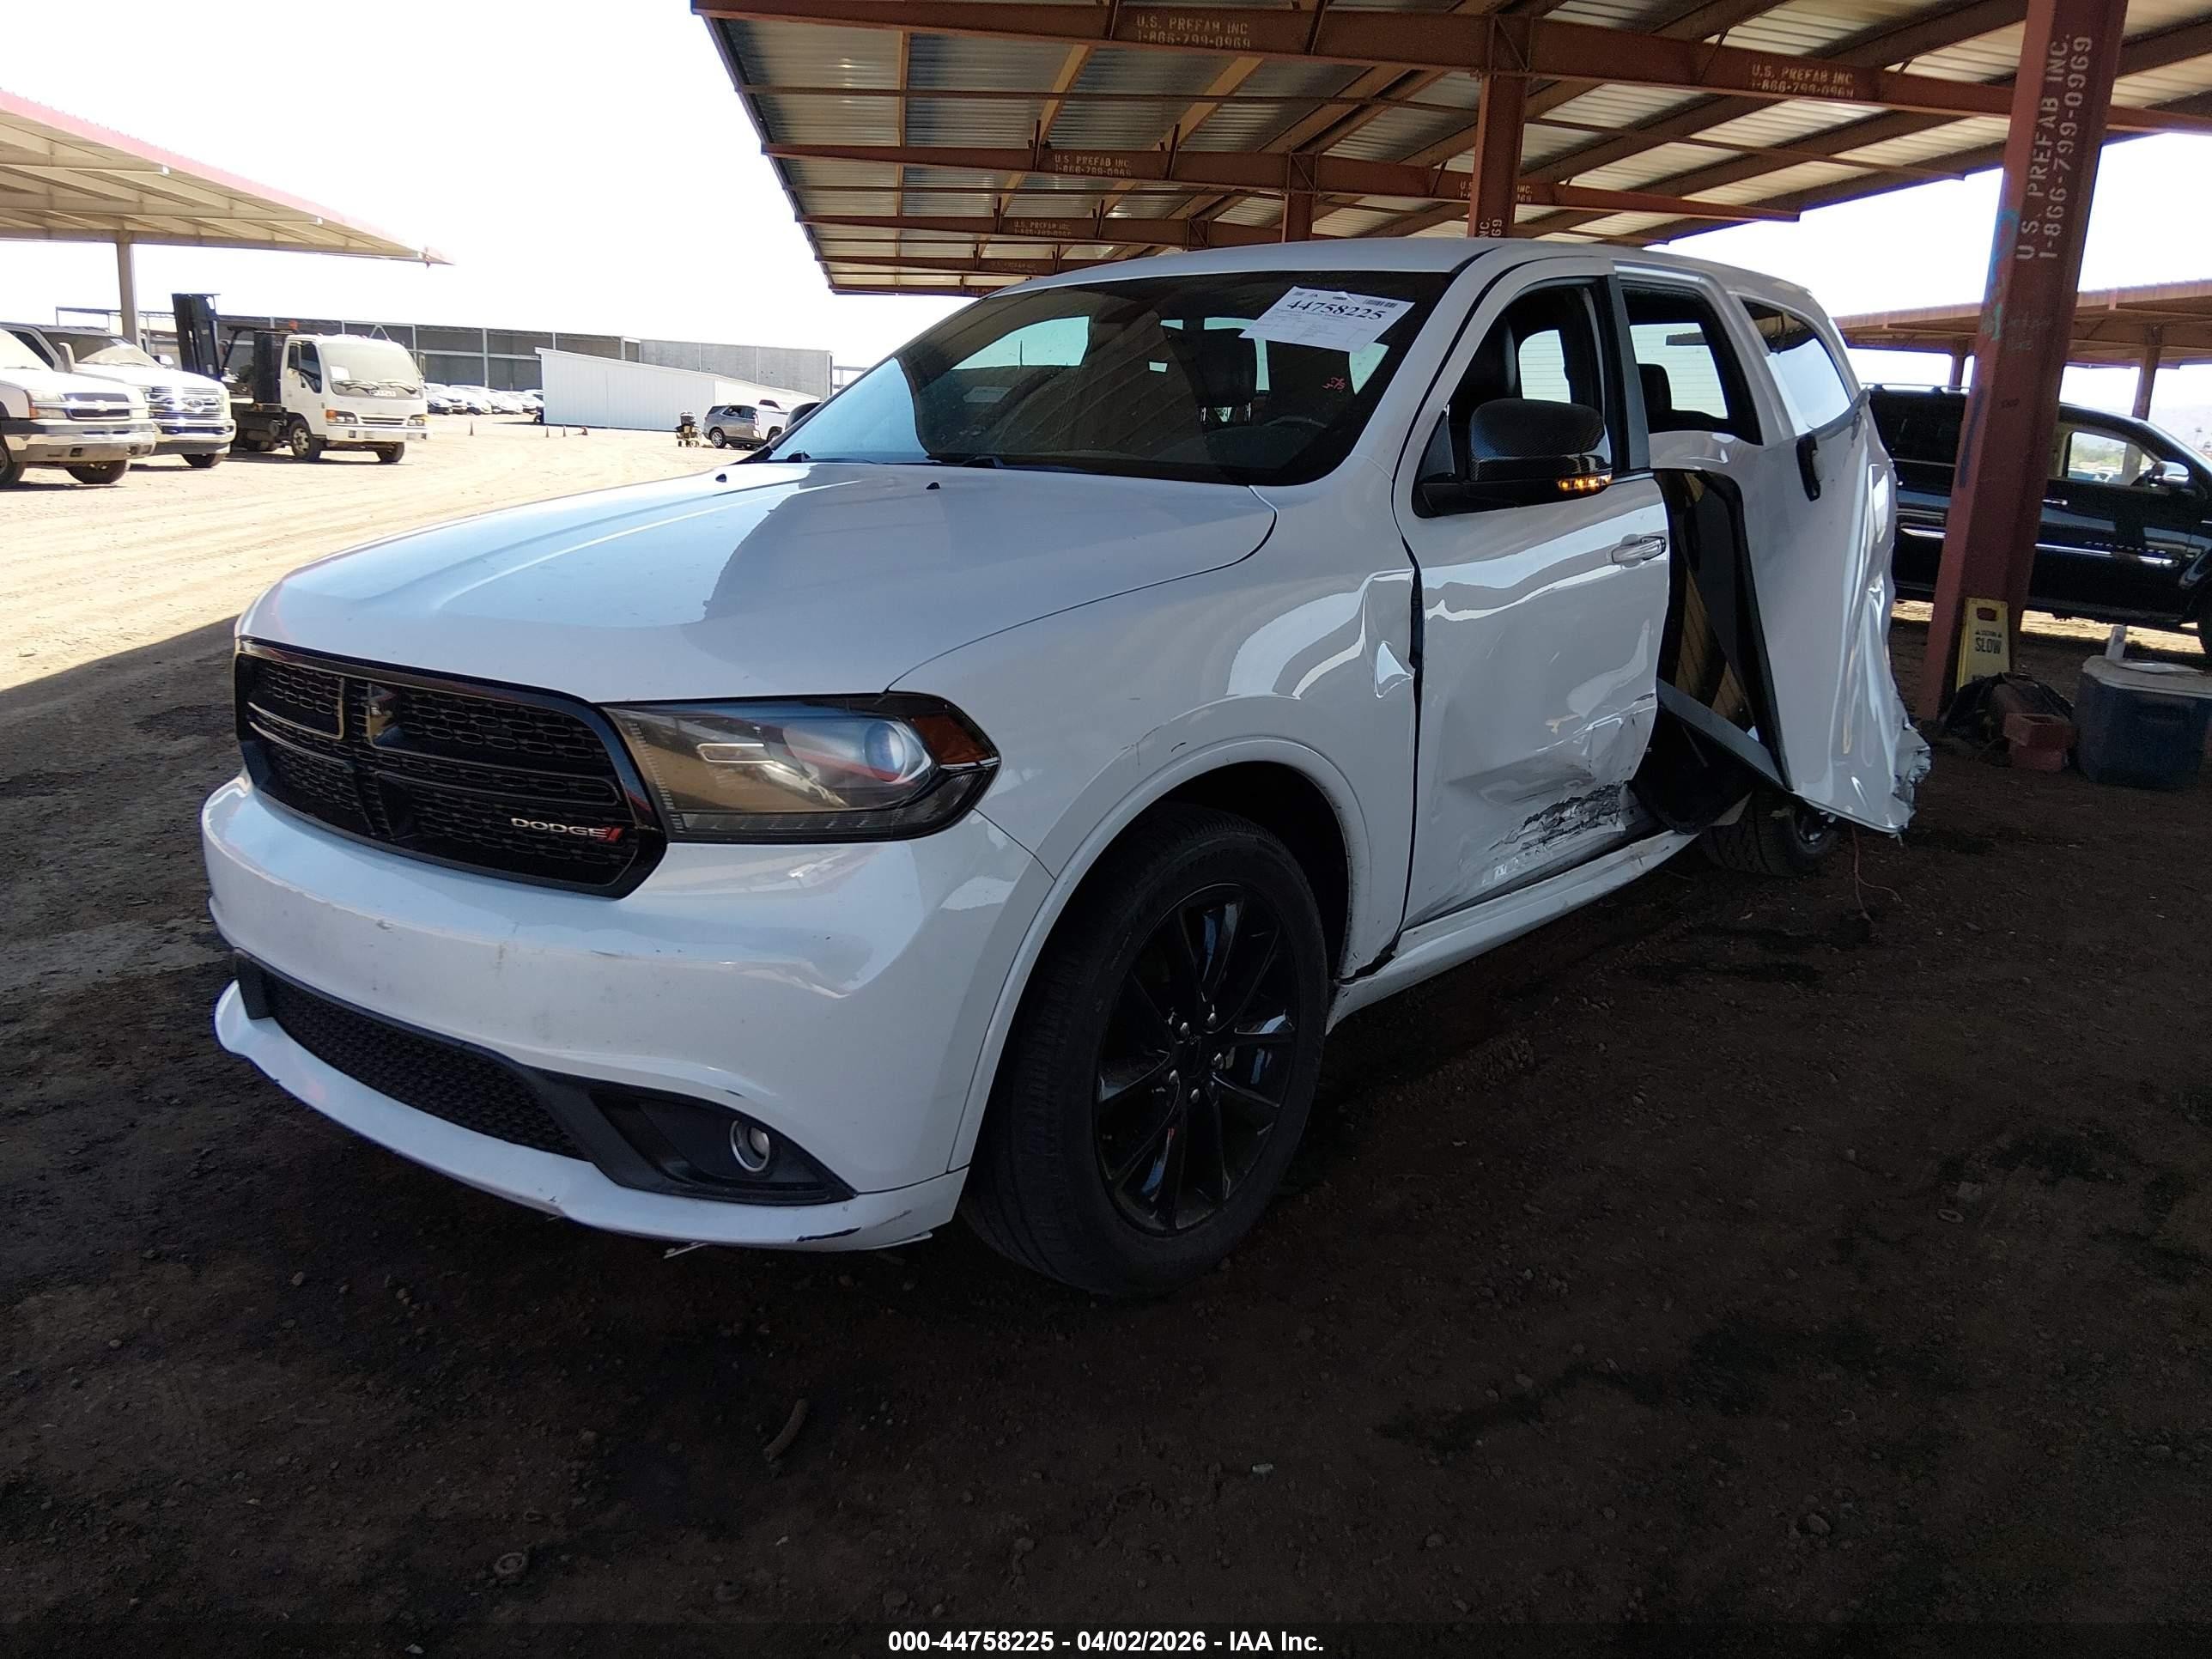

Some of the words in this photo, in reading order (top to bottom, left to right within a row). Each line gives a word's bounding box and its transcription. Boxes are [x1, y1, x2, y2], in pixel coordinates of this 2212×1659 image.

[2045, 34, 2070, 82] INC.
[2027, 97, 2058, 197] PREFAB
[2039, 36, 2093, 258] 1-866-799-0969
[1479, 217, 1491, 238] NC.
[2015, 213, 2043, 260] U.S.
[1286, 300, 1387, 320] 44758225
[1975, 637, 2002, 654] SLOW
[510, 817, 608, 838] DODGE
